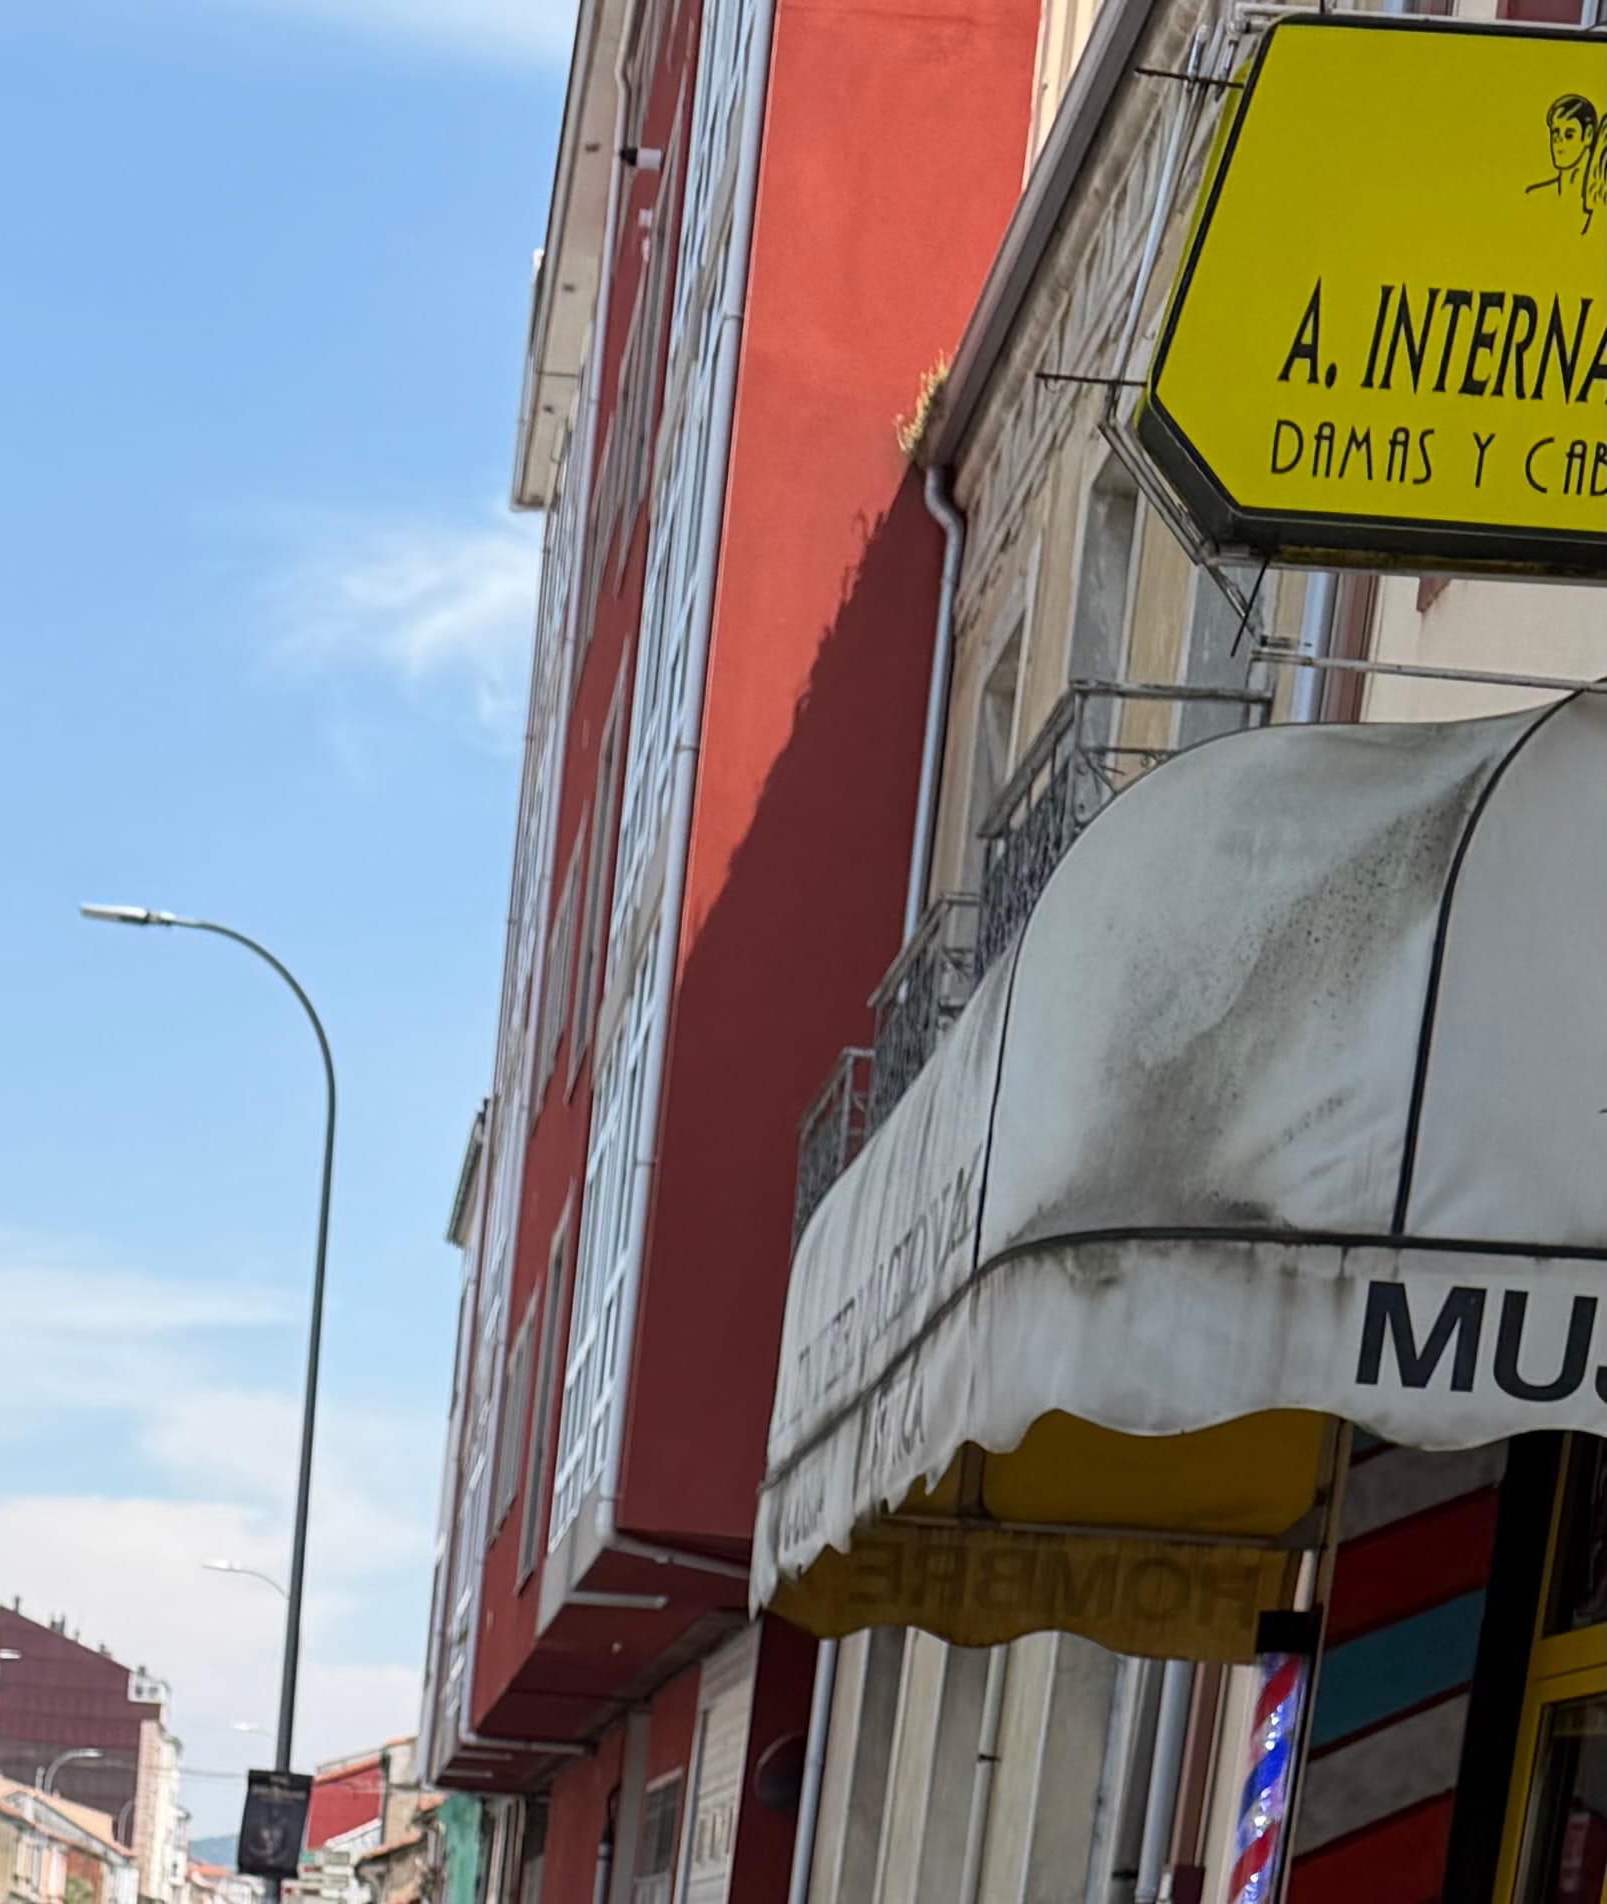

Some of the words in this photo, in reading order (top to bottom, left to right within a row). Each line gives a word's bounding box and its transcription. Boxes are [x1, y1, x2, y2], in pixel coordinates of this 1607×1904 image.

[1277, 275, 1338, 389] A.
[1271, 419, 1435, 486] DAMAS
[1473, 433, 1495, 488] Y
[1355, 1280, 1607, 1405] MU
